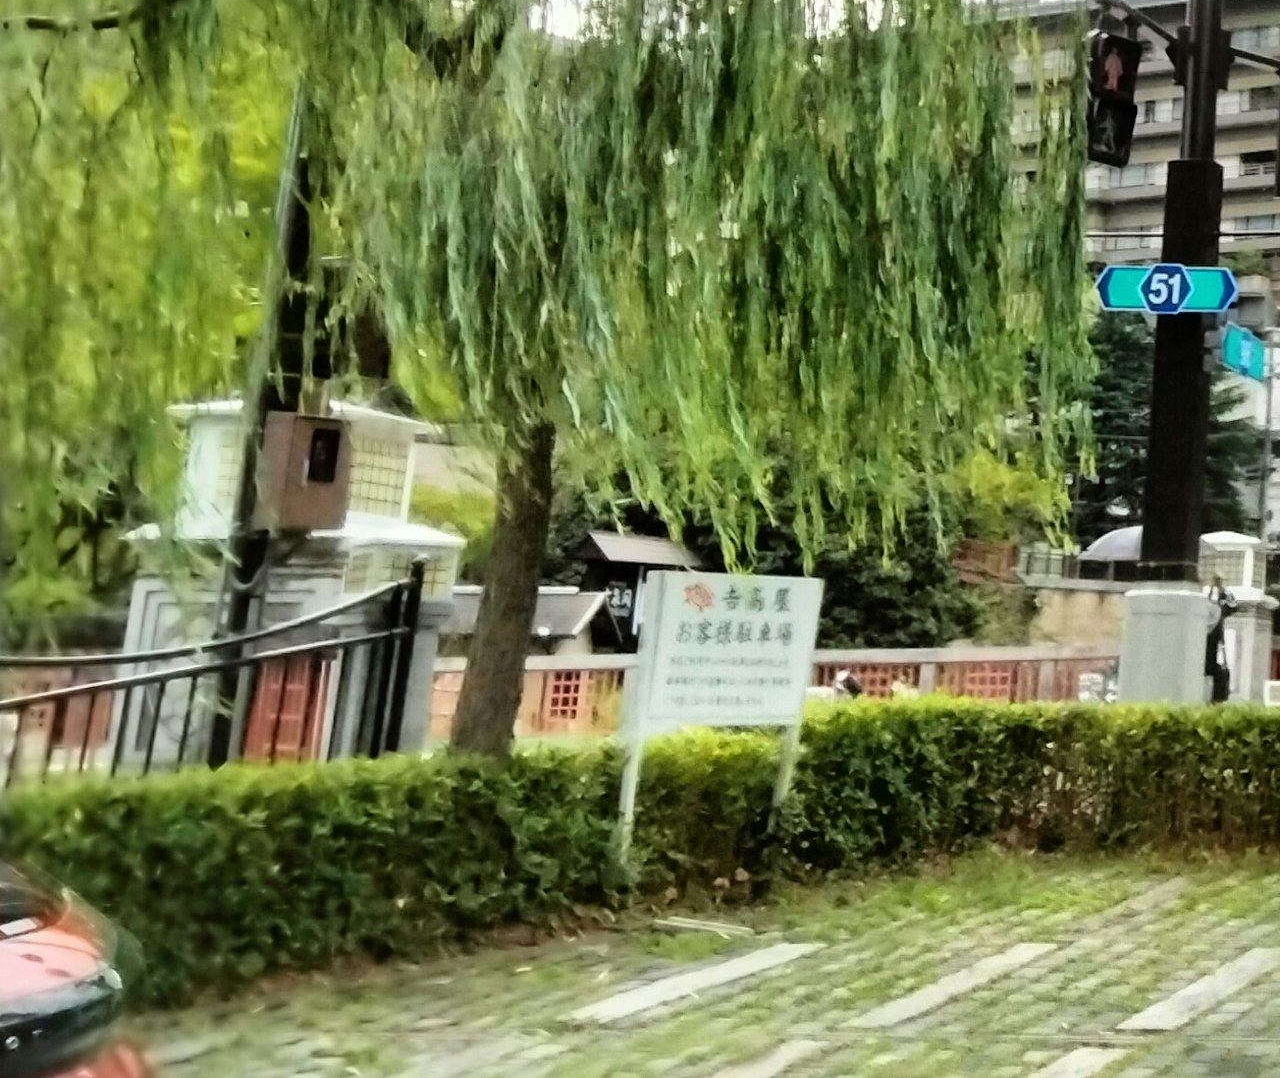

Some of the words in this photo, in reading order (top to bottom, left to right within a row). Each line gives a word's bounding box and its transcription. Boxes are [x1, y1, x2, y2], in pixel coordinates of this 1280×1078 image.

[1148, 273, 1181, 304] 51
[675, 620, 793, 647] お客様駐車場
